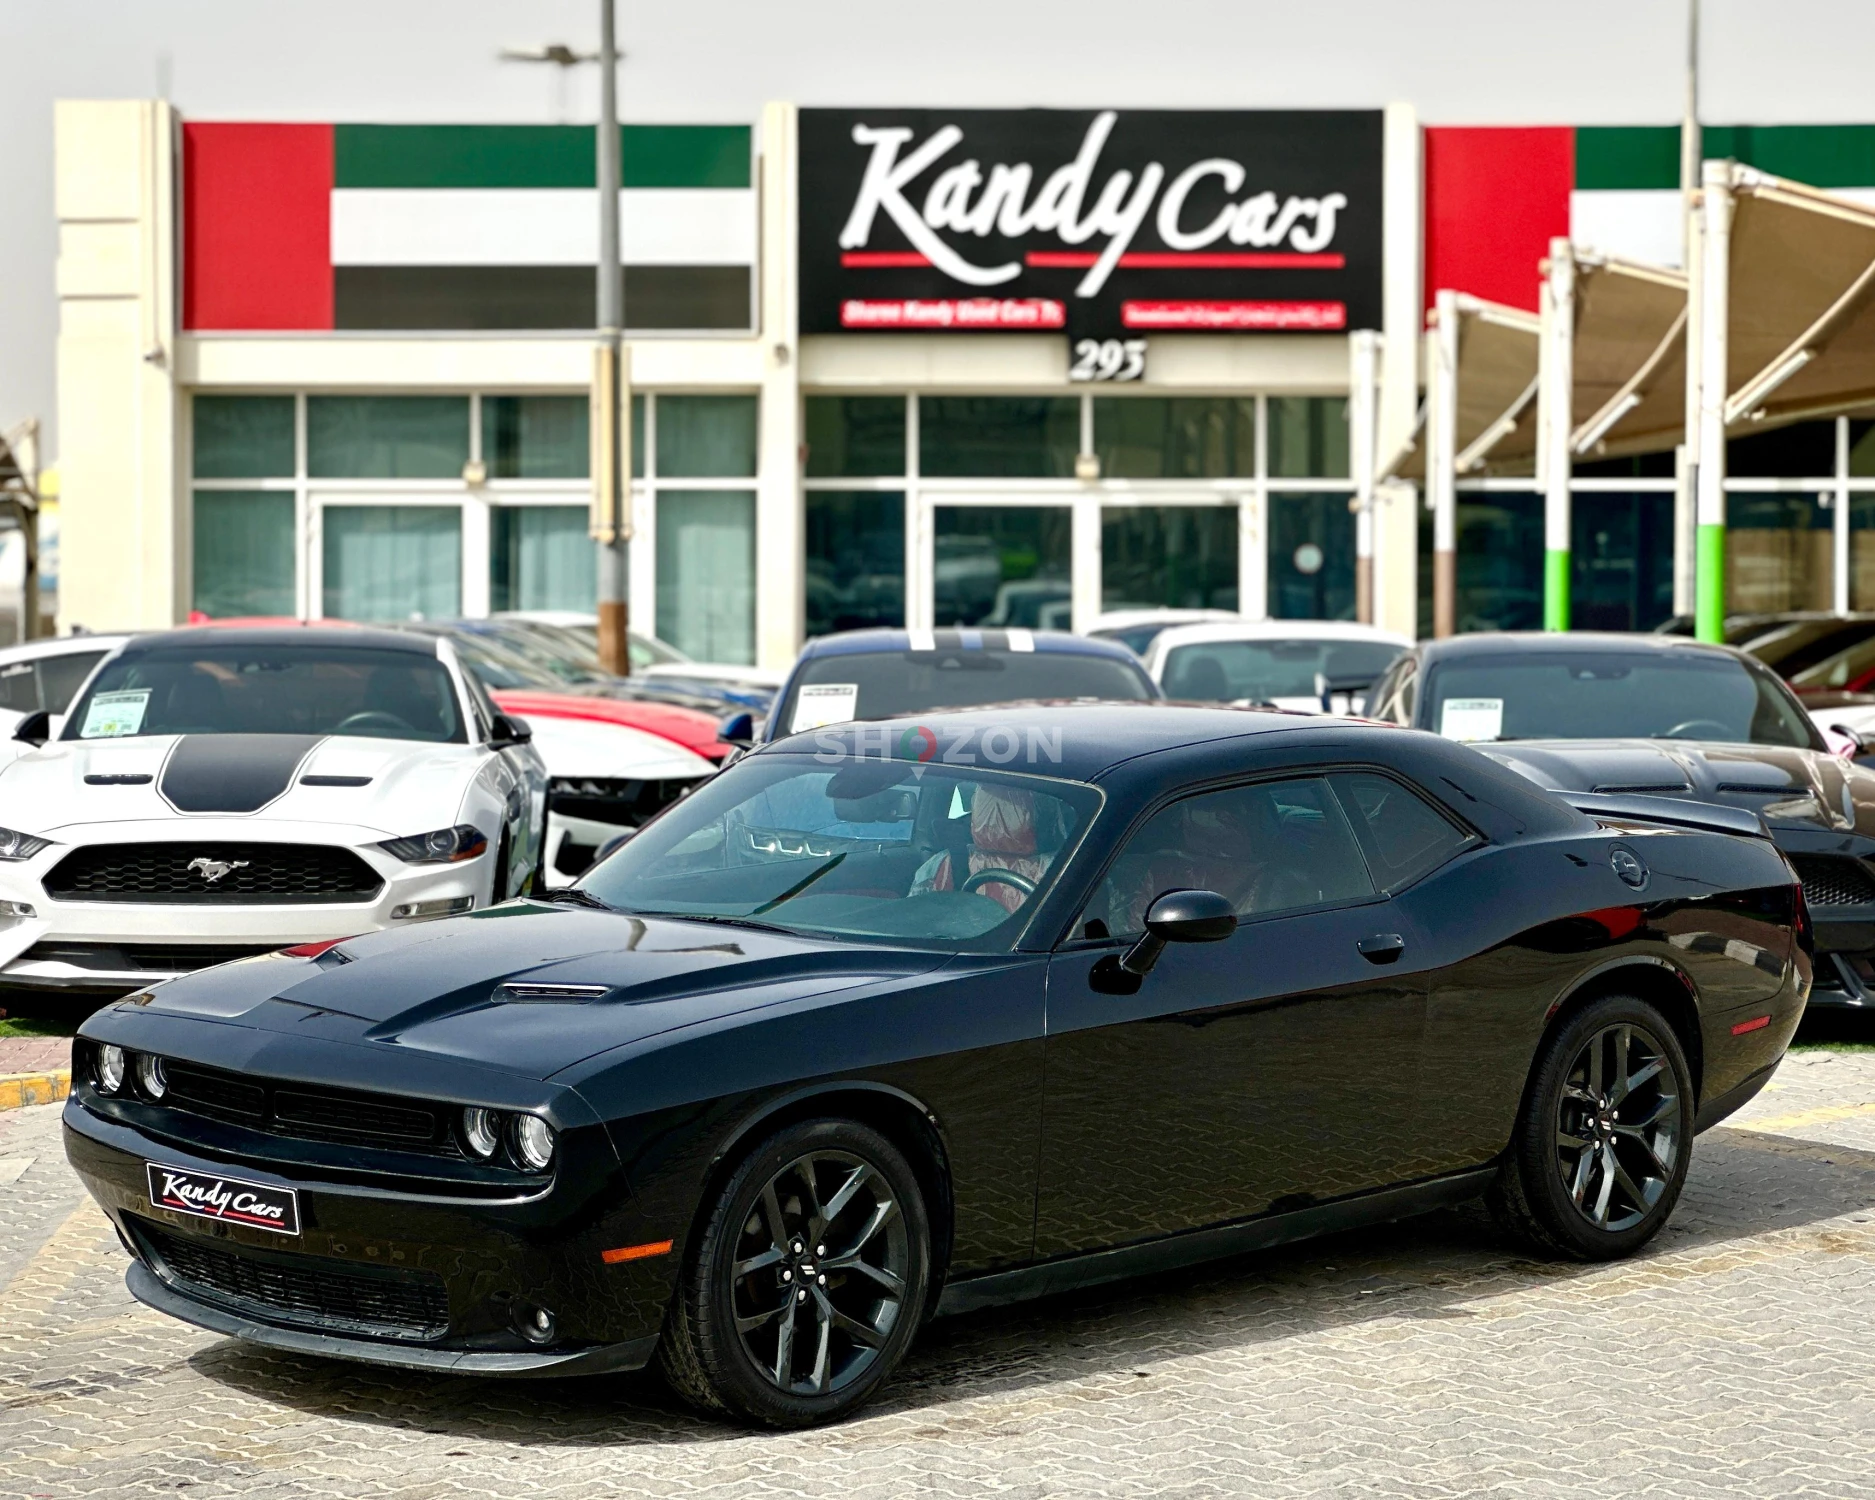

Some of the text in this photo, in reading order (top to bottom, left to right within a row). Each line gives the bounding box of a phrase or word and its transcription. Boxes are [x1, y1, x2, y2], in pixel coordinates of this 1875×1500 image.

[839, 111, 1347, 297] Kandy Cars
[1070, 339, 1148, 381] 295
[162, 1173, 284, 1218] Kandy Cars
